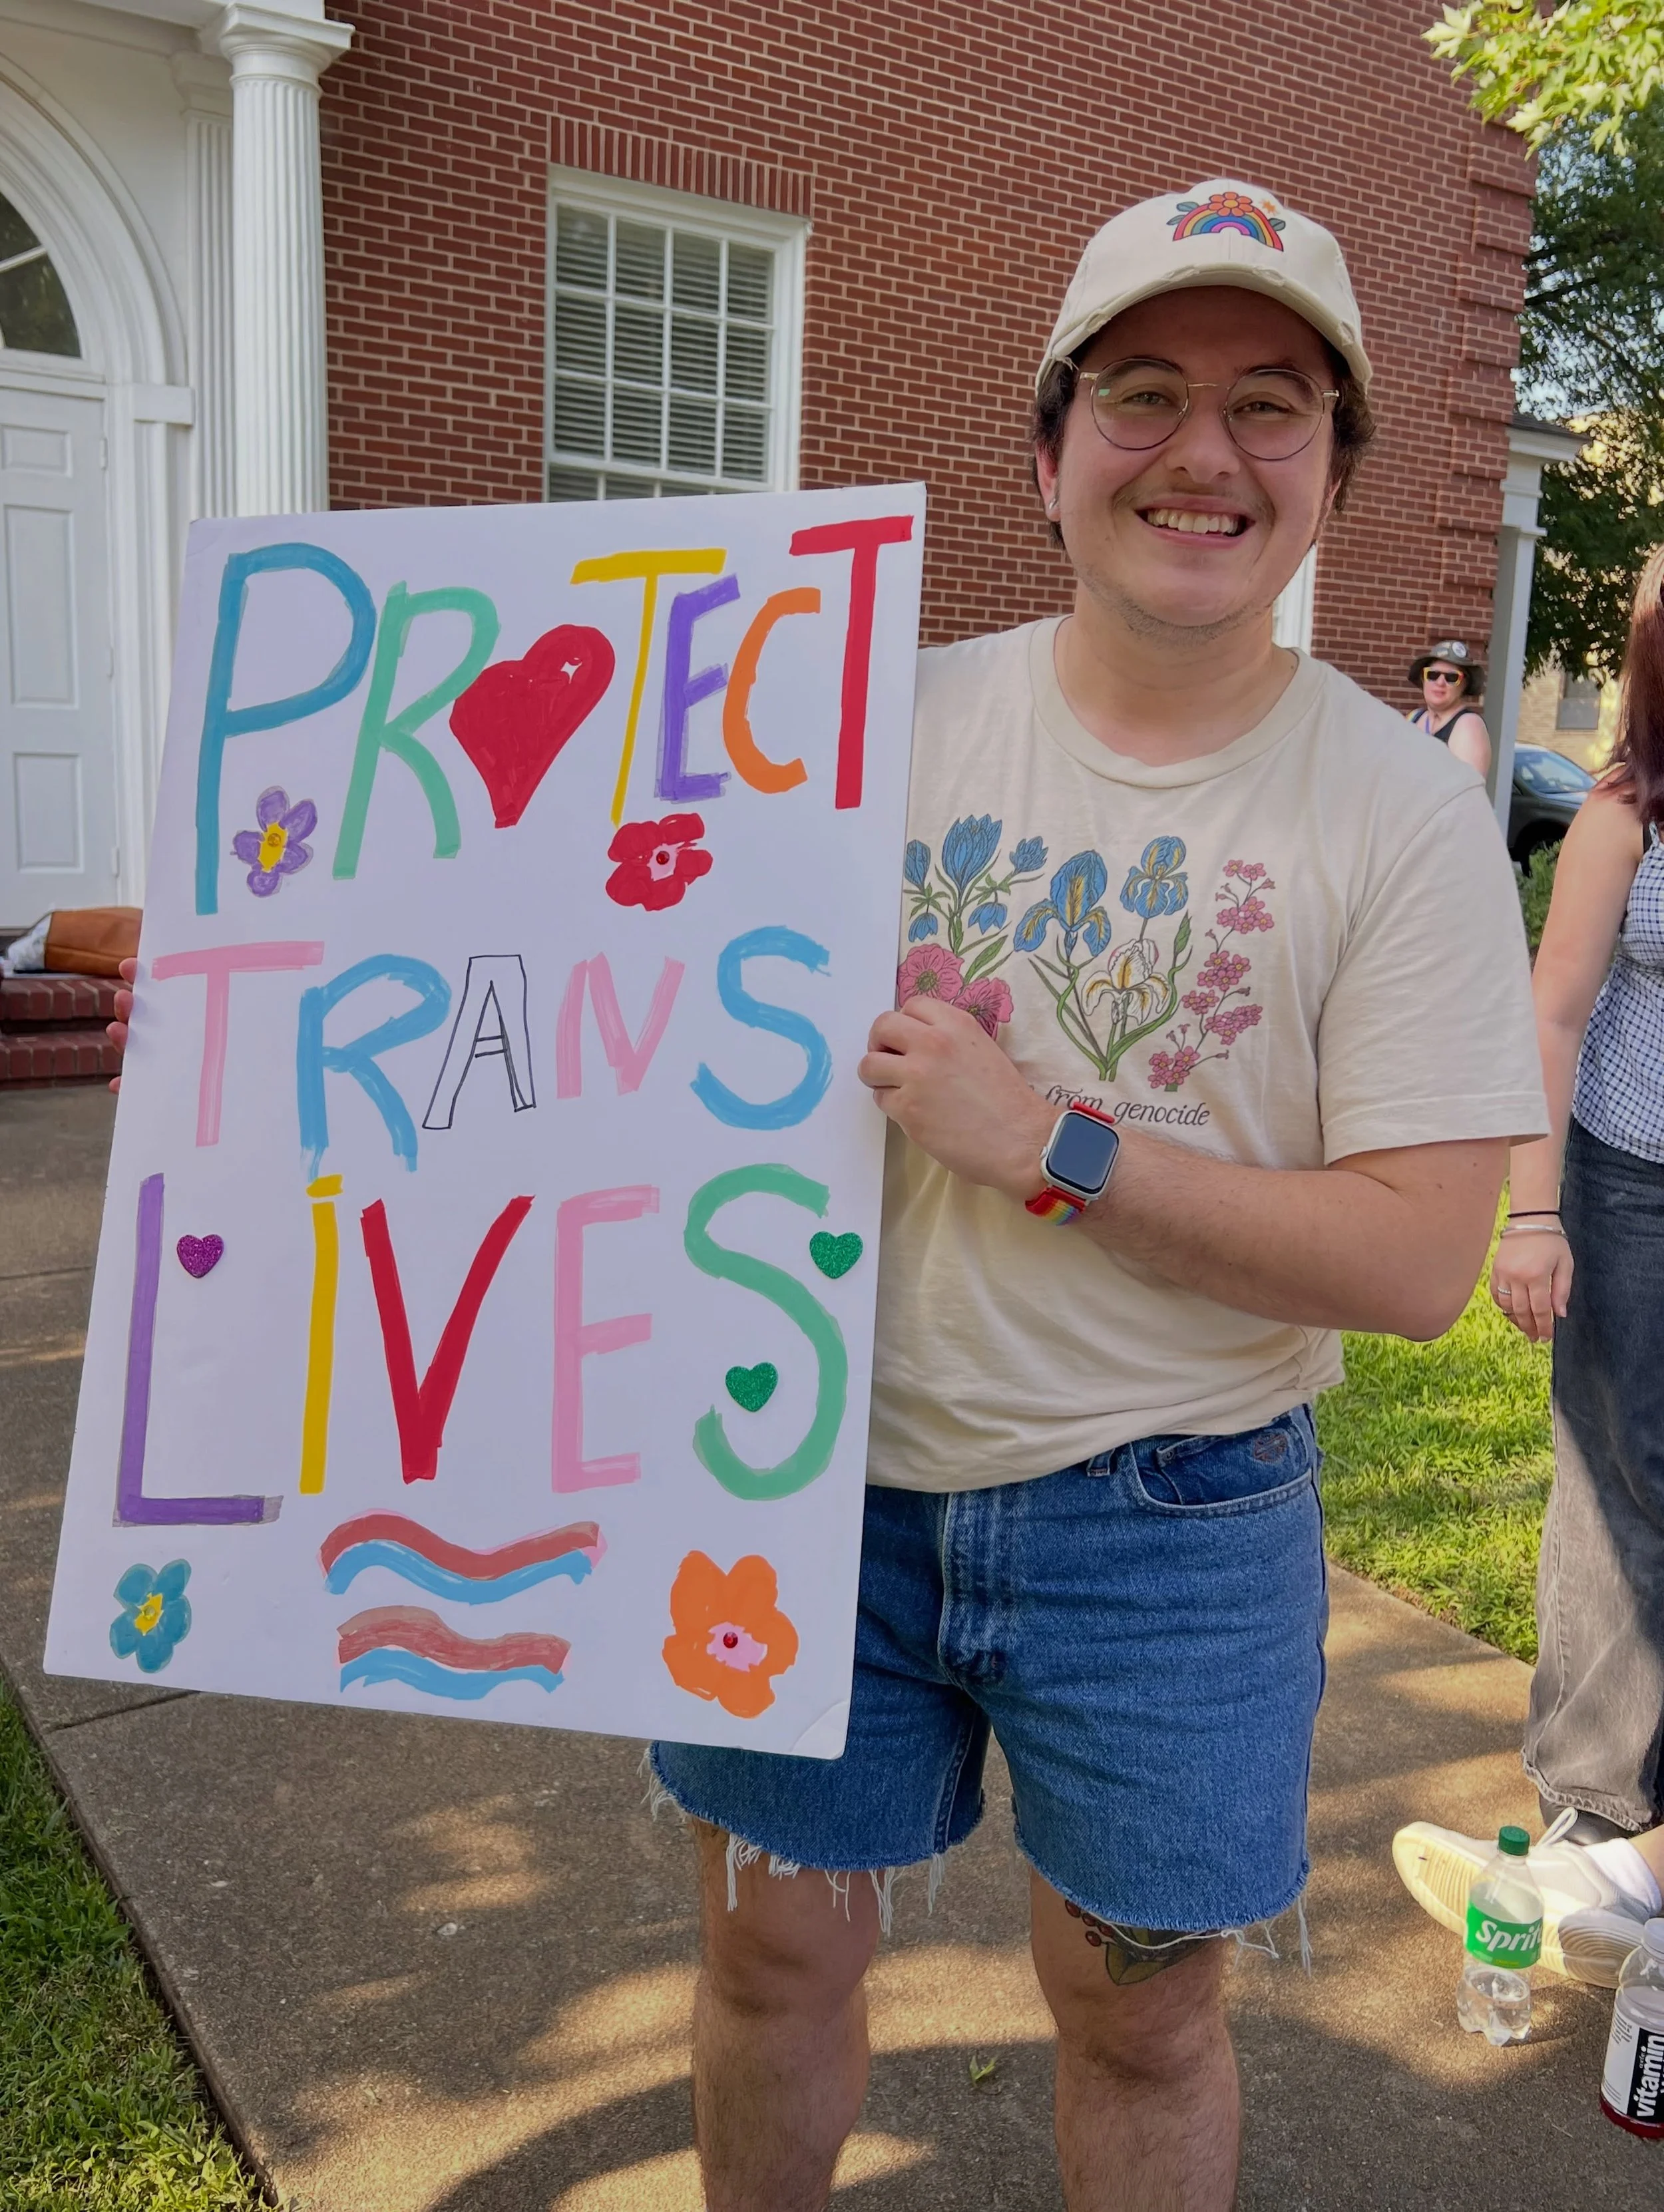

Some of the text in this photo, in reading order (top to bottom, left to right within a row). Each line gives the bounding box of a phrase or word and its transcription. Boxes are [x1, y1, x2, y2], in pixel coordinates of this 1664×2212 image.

[152, 926, 833, 1181] TRANS
[1045, 1085, 1210, 1126] from genocide
[1633, 2035, 1664, 2117] vitamin
